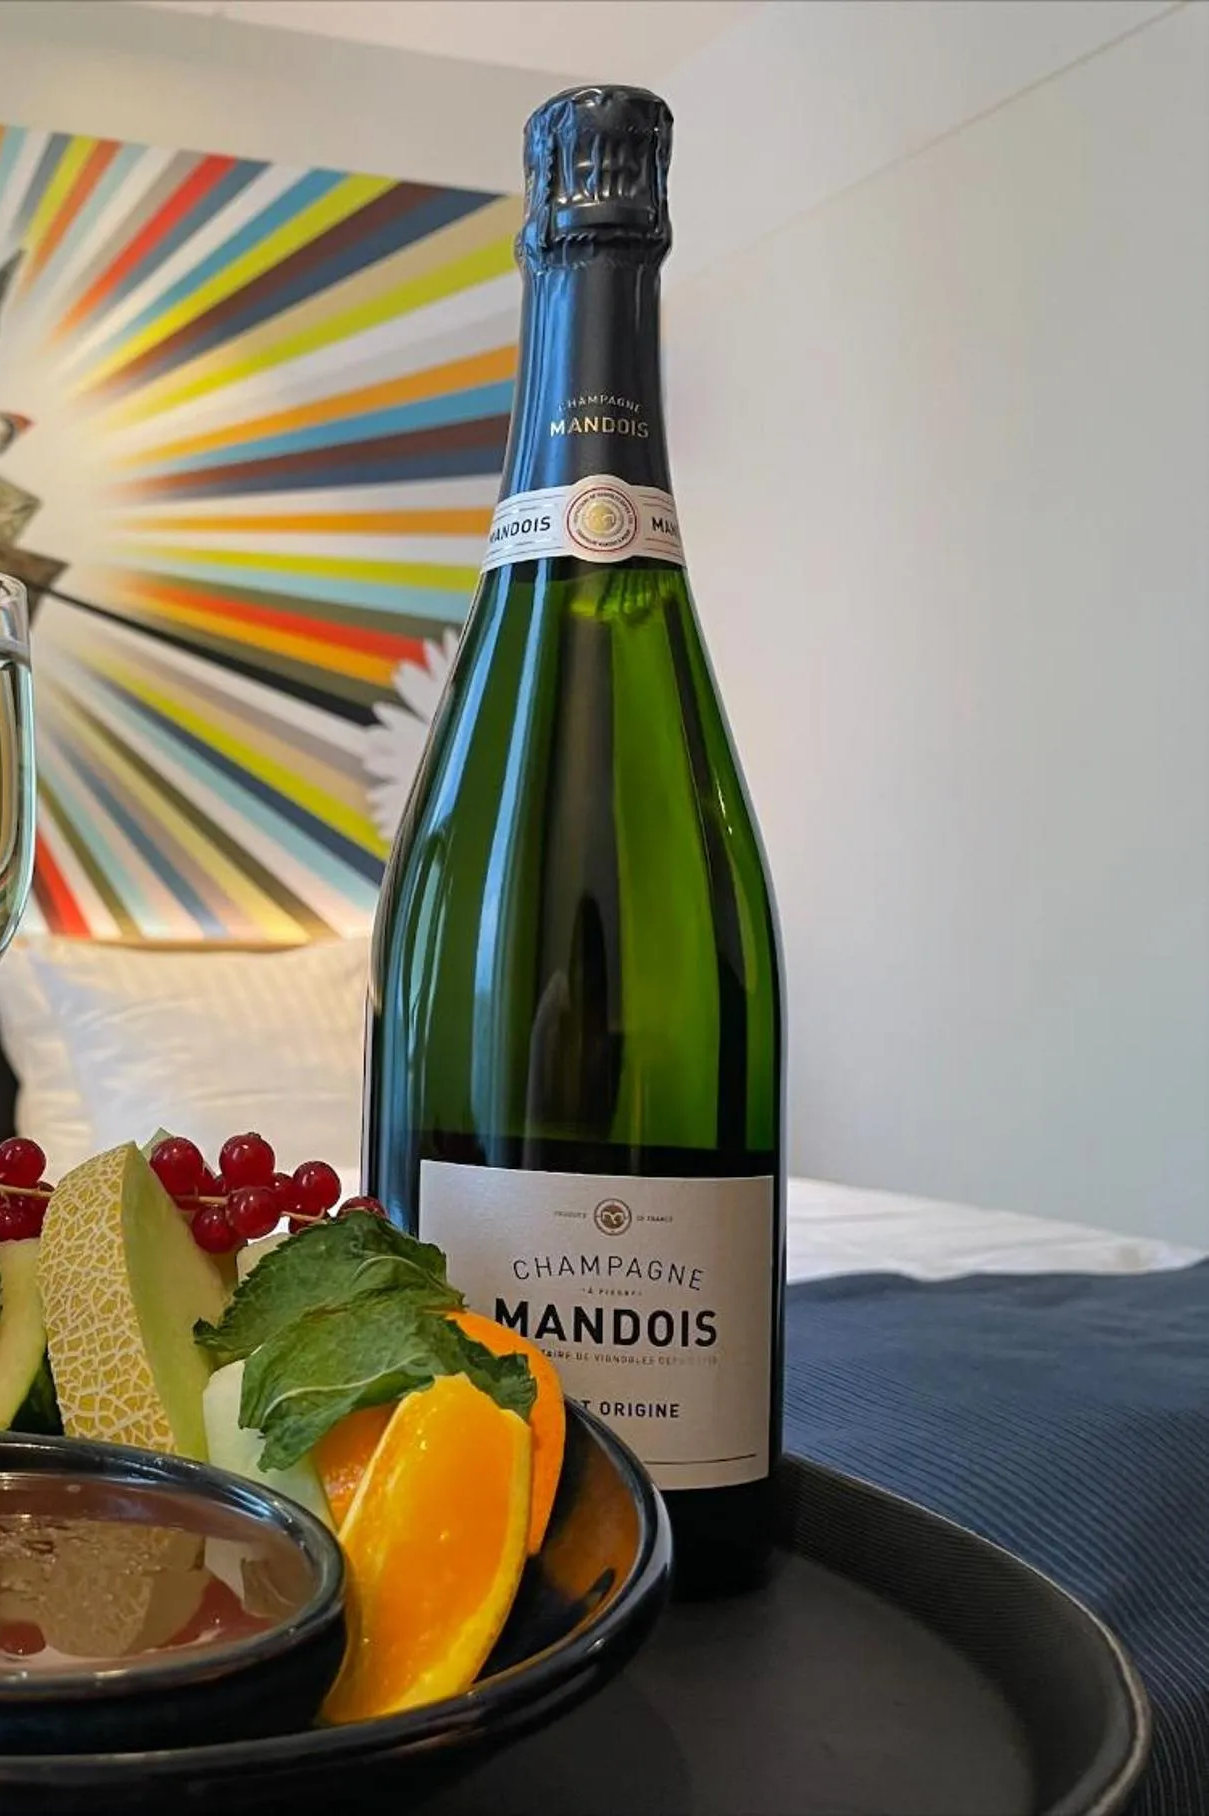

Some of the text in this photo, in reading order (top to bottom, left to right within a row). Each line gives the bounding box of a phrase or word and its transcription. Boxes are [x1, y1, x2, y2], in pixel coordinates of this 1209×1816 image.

[550, 416, 649, 438] MANDOIS
[512, 1254, 706, 1291] CHAMPAGNE
[494, 1297, 718, 1348] MANDOIS
[599, 1400, 681, 1419] ORIGINE
